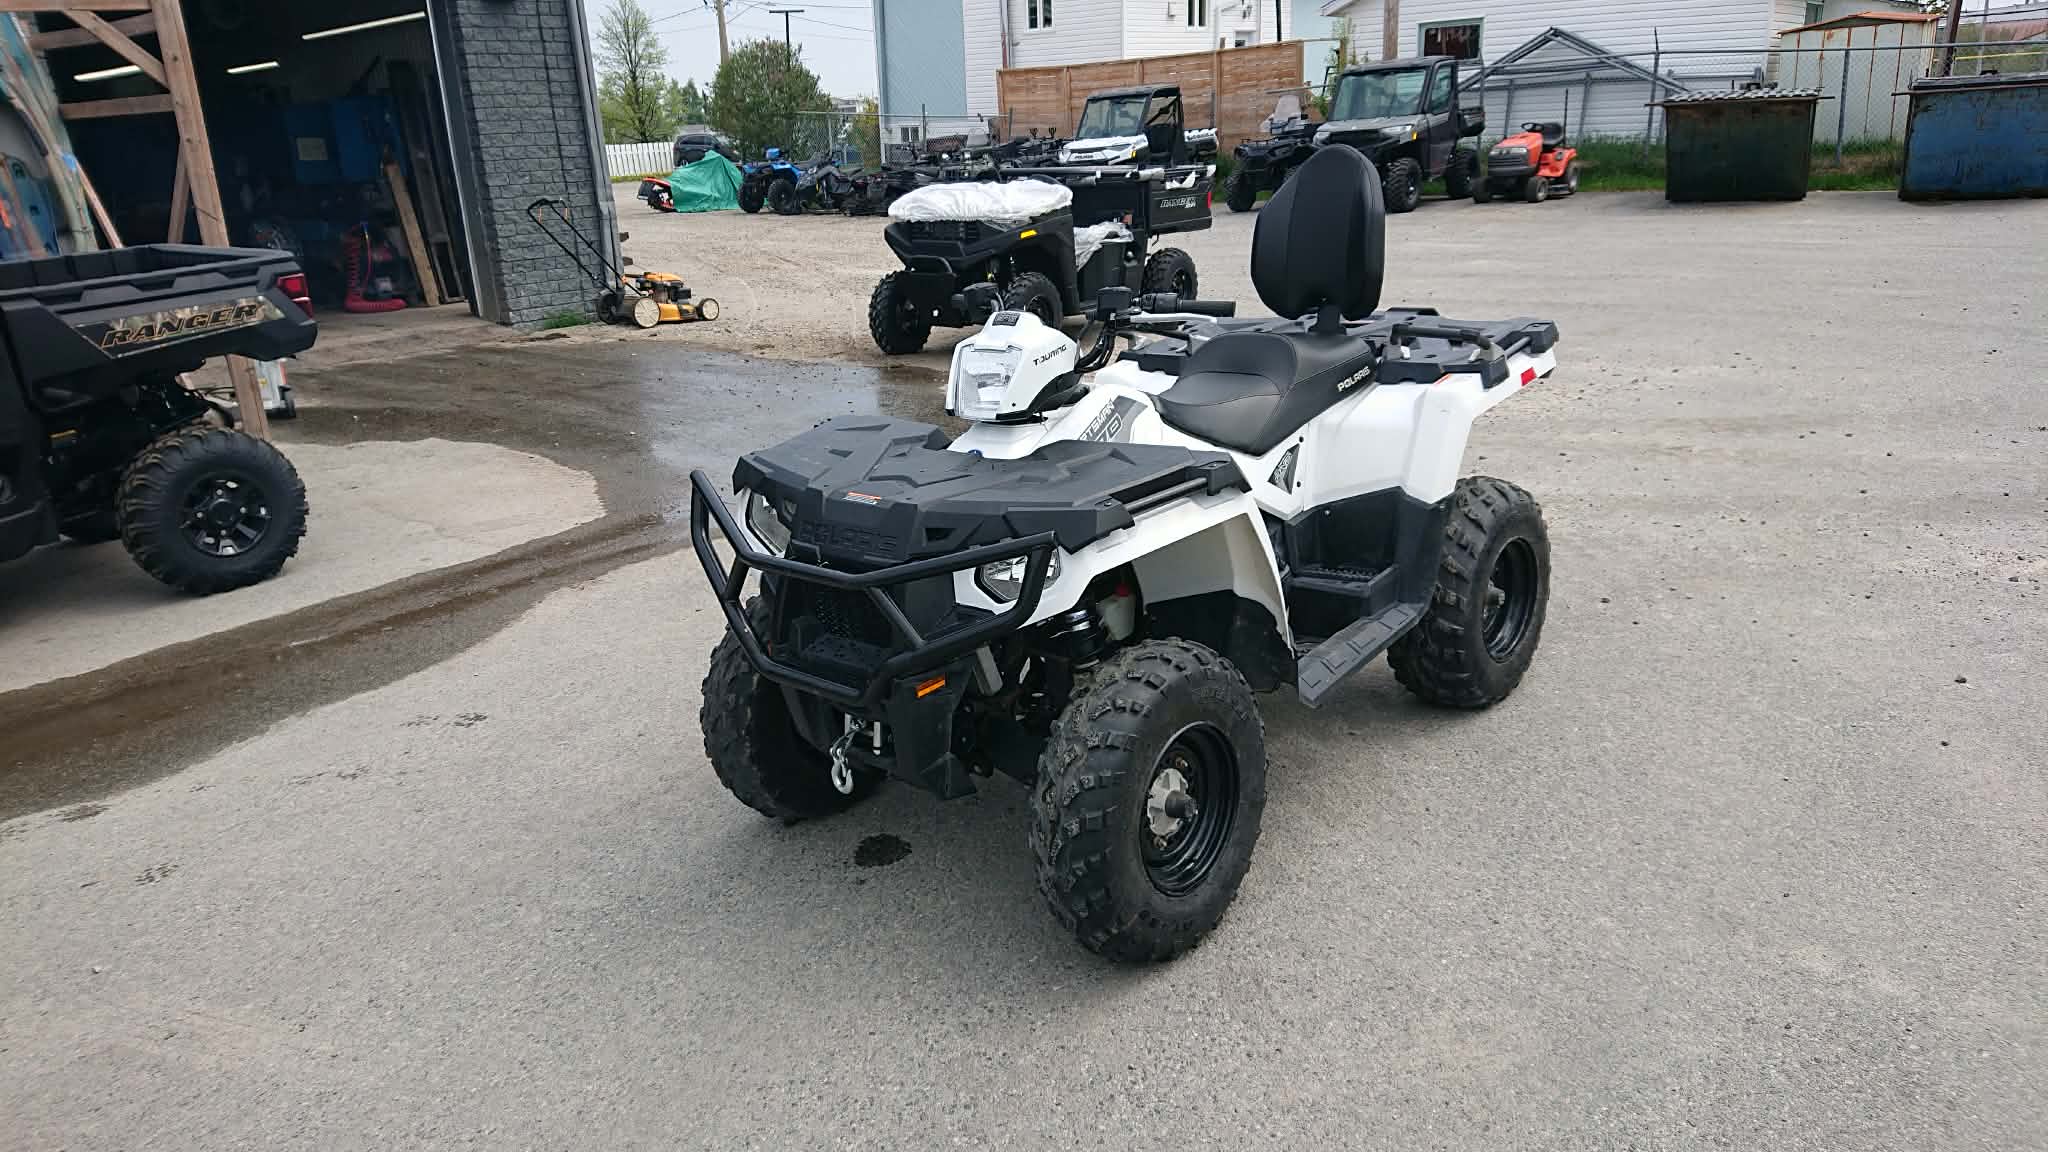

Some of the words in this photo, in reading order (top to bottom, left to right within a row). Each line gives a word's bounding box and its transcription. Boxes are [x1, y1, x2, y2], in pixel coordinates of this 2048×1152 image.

[101, 304, 260, 347] RANGER
[1032, 343, 1067, 367] TOURING
[1337, 365, 1370, 392] POLARIS
